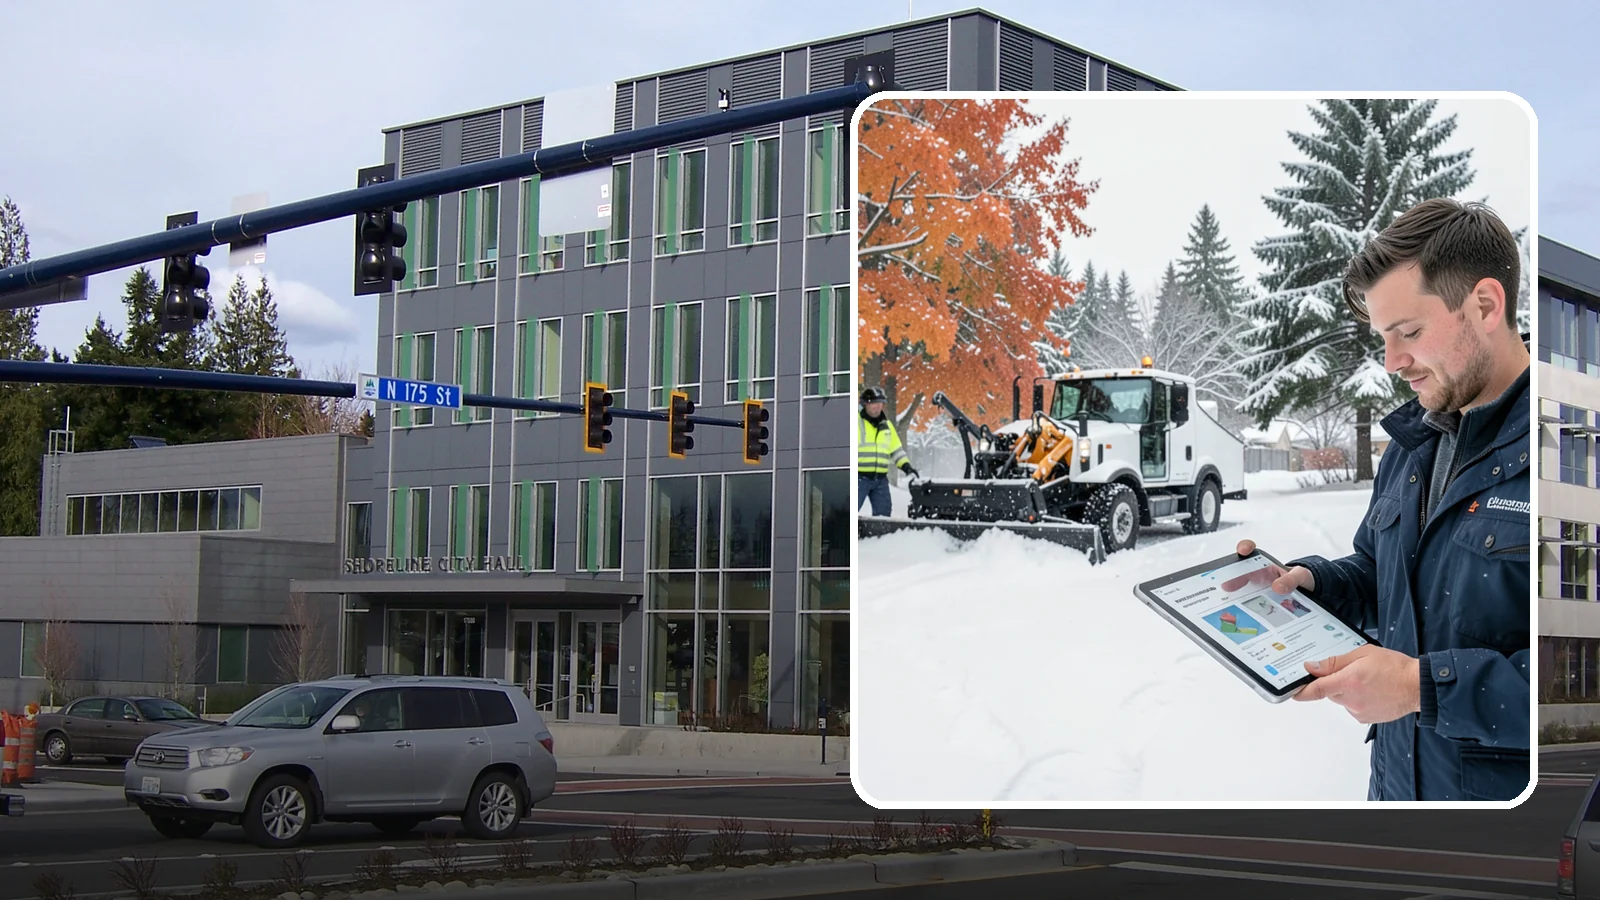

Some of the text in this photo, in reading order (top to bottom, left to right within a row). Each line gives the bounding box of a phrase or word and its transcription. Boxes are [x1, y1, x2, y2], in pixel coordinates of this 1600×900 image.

[387, 380, 451, 406] N 175 St
[344, 555, 525, 574] SHORELINE CITY HALL
